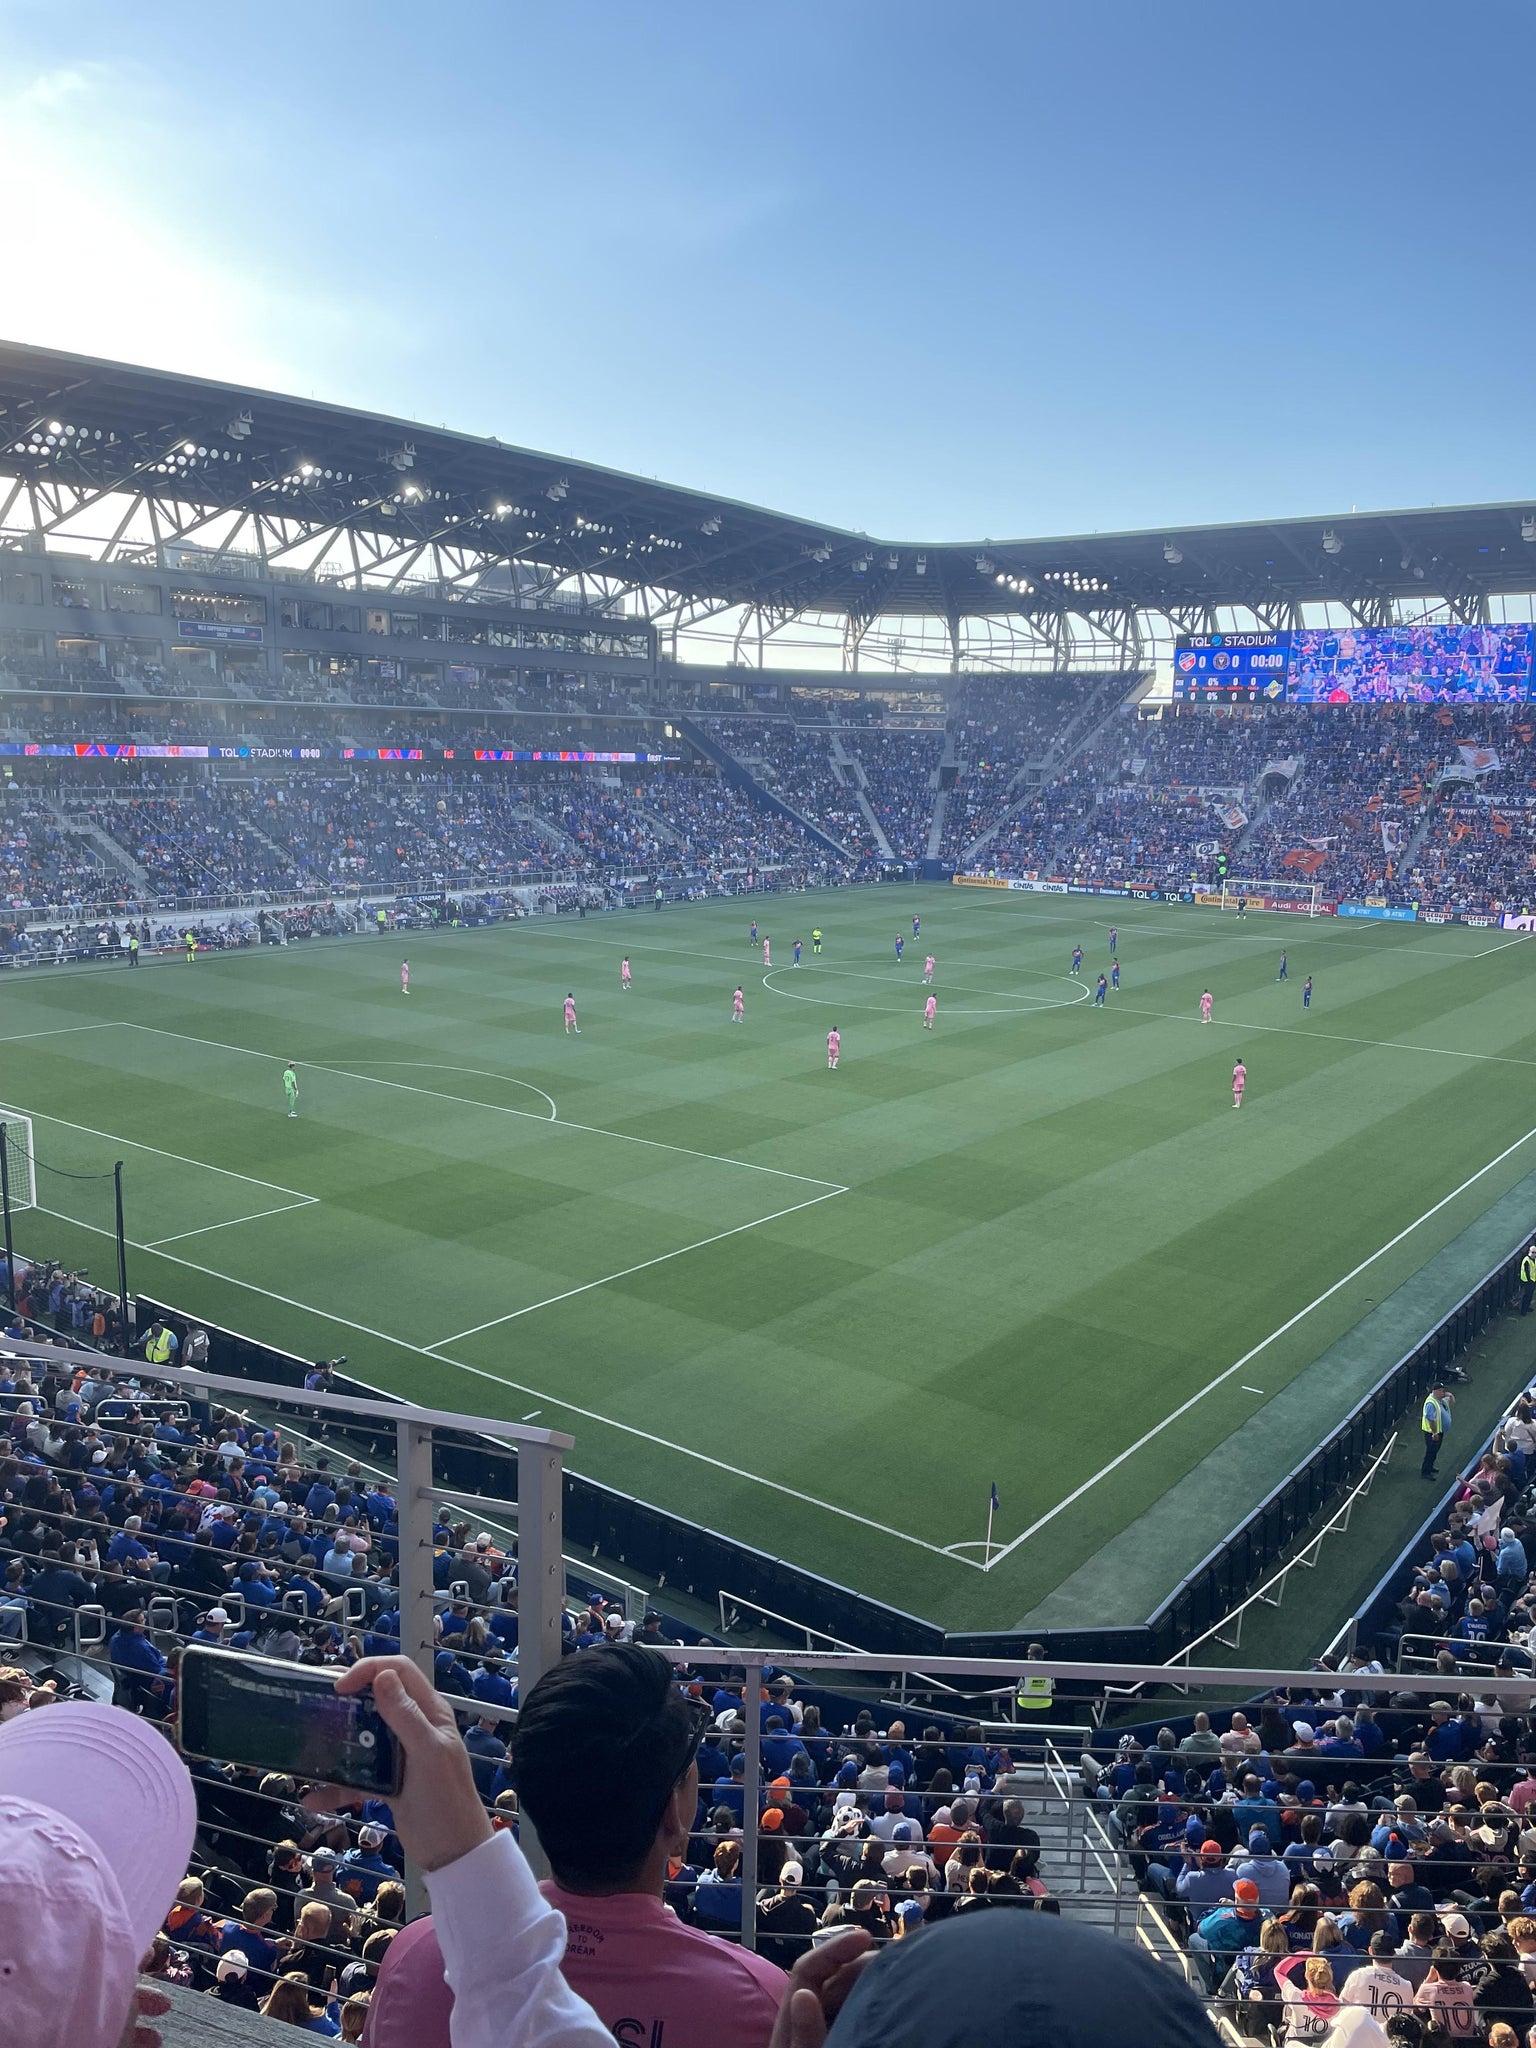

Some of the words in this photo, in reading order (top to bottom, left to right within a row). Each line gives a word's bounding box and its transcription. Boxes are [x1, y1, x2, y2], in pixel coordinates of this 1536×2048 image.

[1189, 637, 1211, 647] TQL
[1224, 635, 1277, 646] STADIUM
[1198, 655, 1206, 668] 0
[1231, 655, 1240, 668] 0
[1250, 654, 1283, 667] 00:00
[1207, 677, 1219, 686] 0%
[1206, 691, 1218, 700] 0%
[220, 748, 239, 758] TQL
[250, 749, 293, 758] STADIUM
[300, 748, 320, 758] 00:00
[957, 877, 988, 885] Continental
[1013, 882, 1034, 890] CINTAS
[1042, 884, 1064, 892] CINTAS
[1131, 890, 1150, 899] TQL
[1164, 893, 1183, 902] TQL
[1201, 895, 1238, 904] Continntal
[1271, 901, 1291, 909] Audi
[1418, 911, 1453, 920] DISCOUNT
[1461, 914, 1497, 923] DISCOUNT
[567, 1924, 605, 1944] REEDOM
[577, 1934, 588, 1944] TO
[1374, 1972, 1401, 1985] MESSI
[1437, 1986, 1465, 1995] MESSI
[1368, 1985, 1404, 2021] 10
[1434, 2000, 1473, 2032] 10
